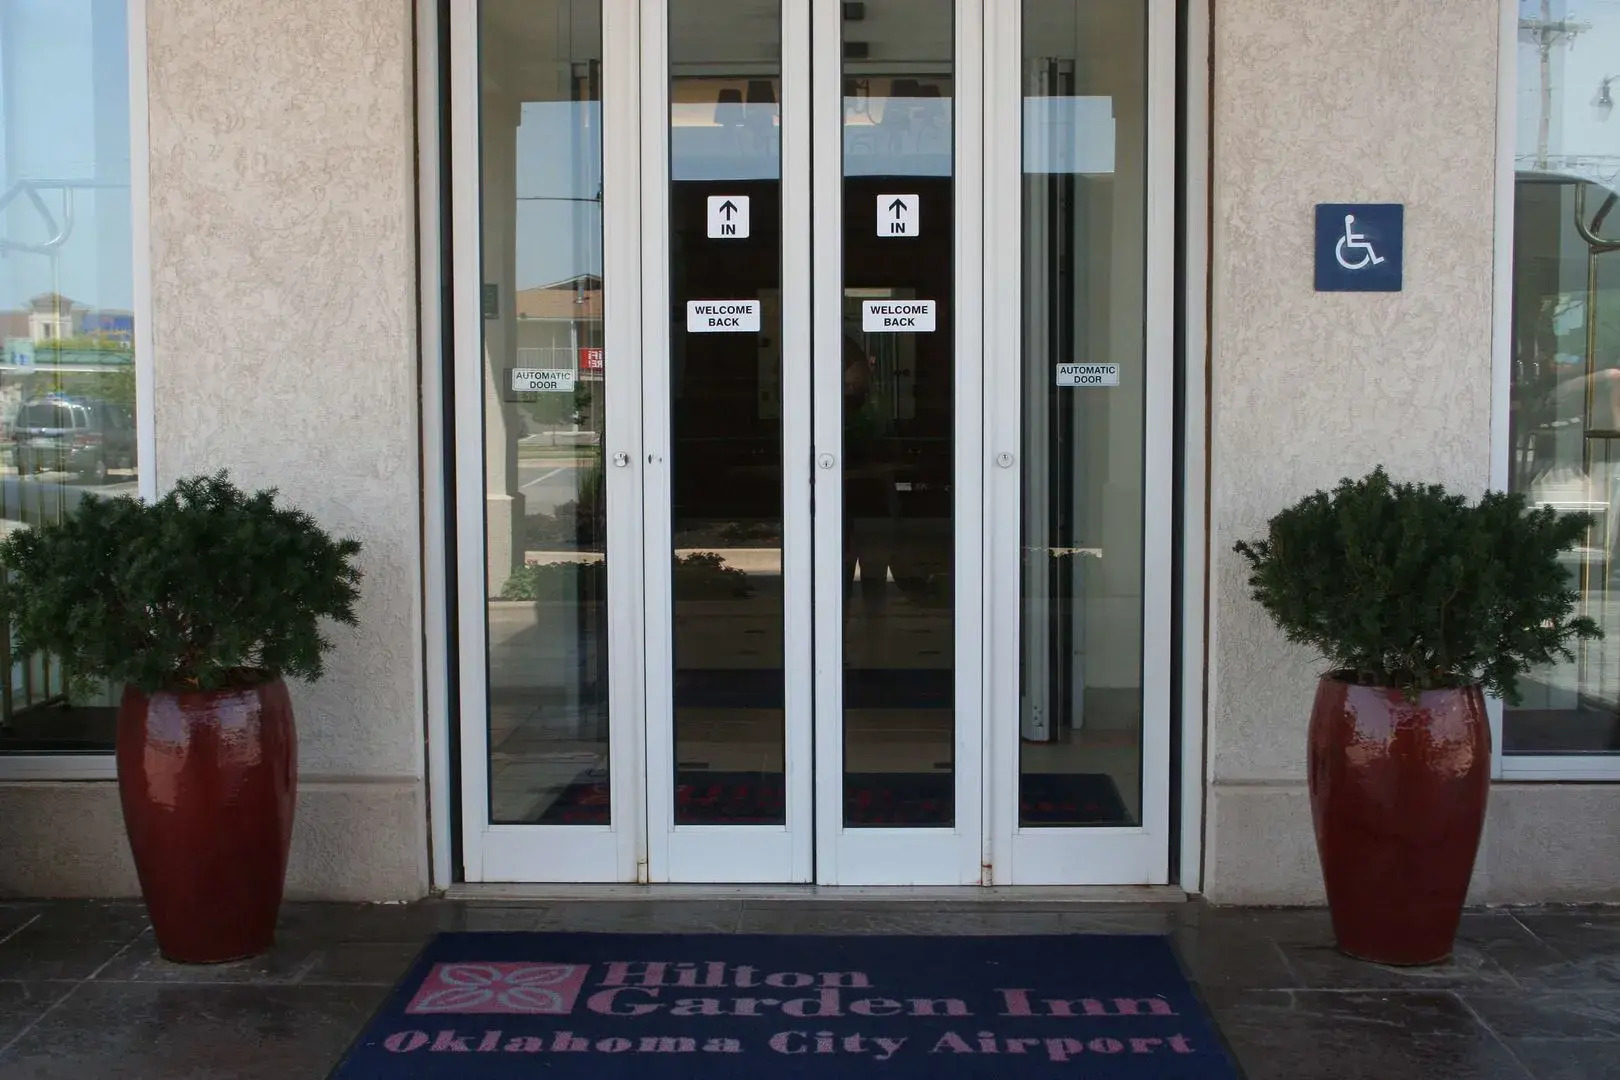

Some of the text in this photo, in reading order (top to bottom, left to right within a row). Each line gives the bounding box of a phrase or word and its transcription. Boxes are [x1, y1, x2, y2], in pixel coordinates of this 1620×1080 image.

[721, 224, 736, 235] IN
[890, 222, 906, 234] IN
[695, 305, 752, 315] WELCOME
[870, 305, 928, 315] WELCOME
[708, 318, 739, 327] BACK
[884, 318, 915, 327] BACK
[1060, 366, 1116, 374] AUTOMATIC
[516, 371, 571, 380] AUTOMATIC
[1074, 375, 1102, 384] DOOR
[530, 381, 557, 389] DOOR
[596, 961, 874, 988] Hilton
[587, 986, 1180, 1017] Garden Inn
[383, 1030, 1196, 1062] Oklahoma City Airport
